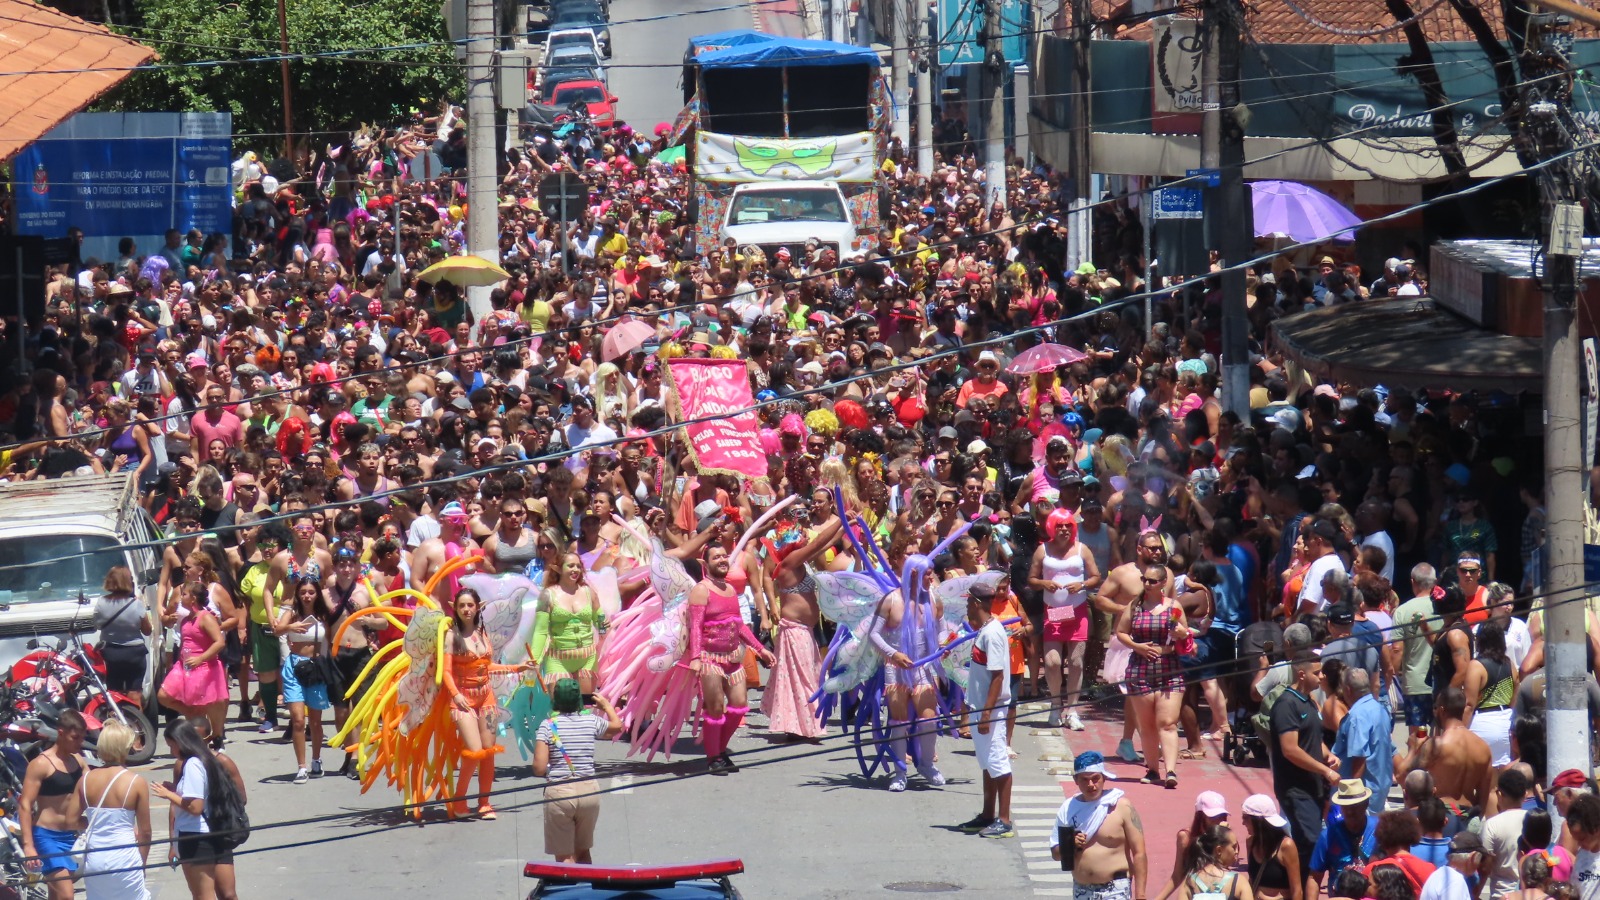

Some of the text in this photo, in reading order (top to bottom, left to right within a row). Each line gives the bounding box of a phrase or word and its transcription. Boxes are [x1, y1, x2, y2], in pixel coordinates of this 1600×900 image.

[1348, 103, 1432, 132] Padari
[72, 169, 170, 181] REFORMA E INSTALAÇÃO PREDIAL
[92, 186, 98, 195] O
[99, 185, 121, 195] PRÉDIO
[123, 186, 138, 194] SEDE
[141, 186, 151, 194] DA
[690, 366, 733, 383] BLOCO
[693, 428, 715, 445] PELOS
[700, 443, 711, 454] DA
[715, 438, 743, 448] SABESP
[723, 449, 758, 459] 1984
